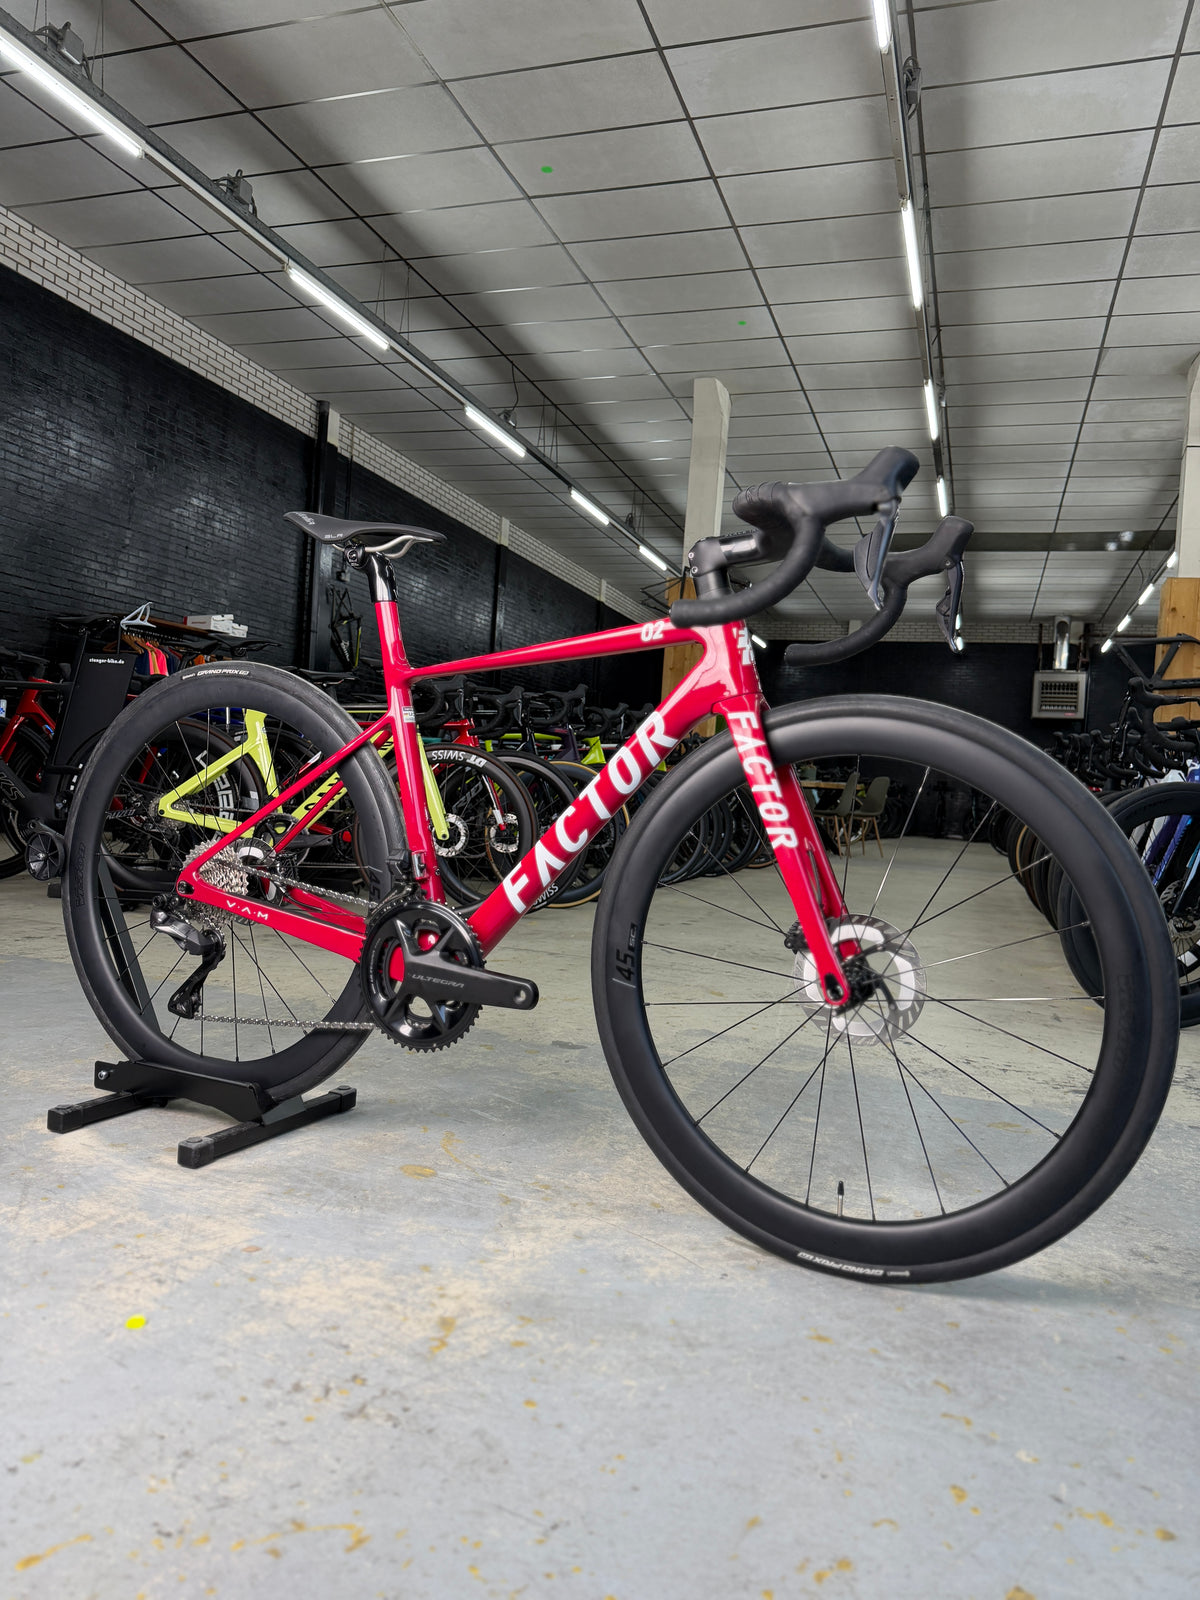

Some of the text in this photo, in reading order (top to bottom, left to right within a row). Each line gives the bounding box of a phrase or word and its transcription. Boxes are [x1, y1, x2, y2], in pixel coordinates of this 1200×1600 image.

[641, 620, 664, 642] 02
[431, 750, 488, 768] DT SWISS
[727, 711, 798, 850] FACTOR
[503, 711, 679, 914] FACTOR
[615, 948, 636, 982] 45
[411, 974, 465, 988] ULTEGRA
[812, 1256, 843, 1269] PRIX
[841, 1264, 884, 1276] GRAND
